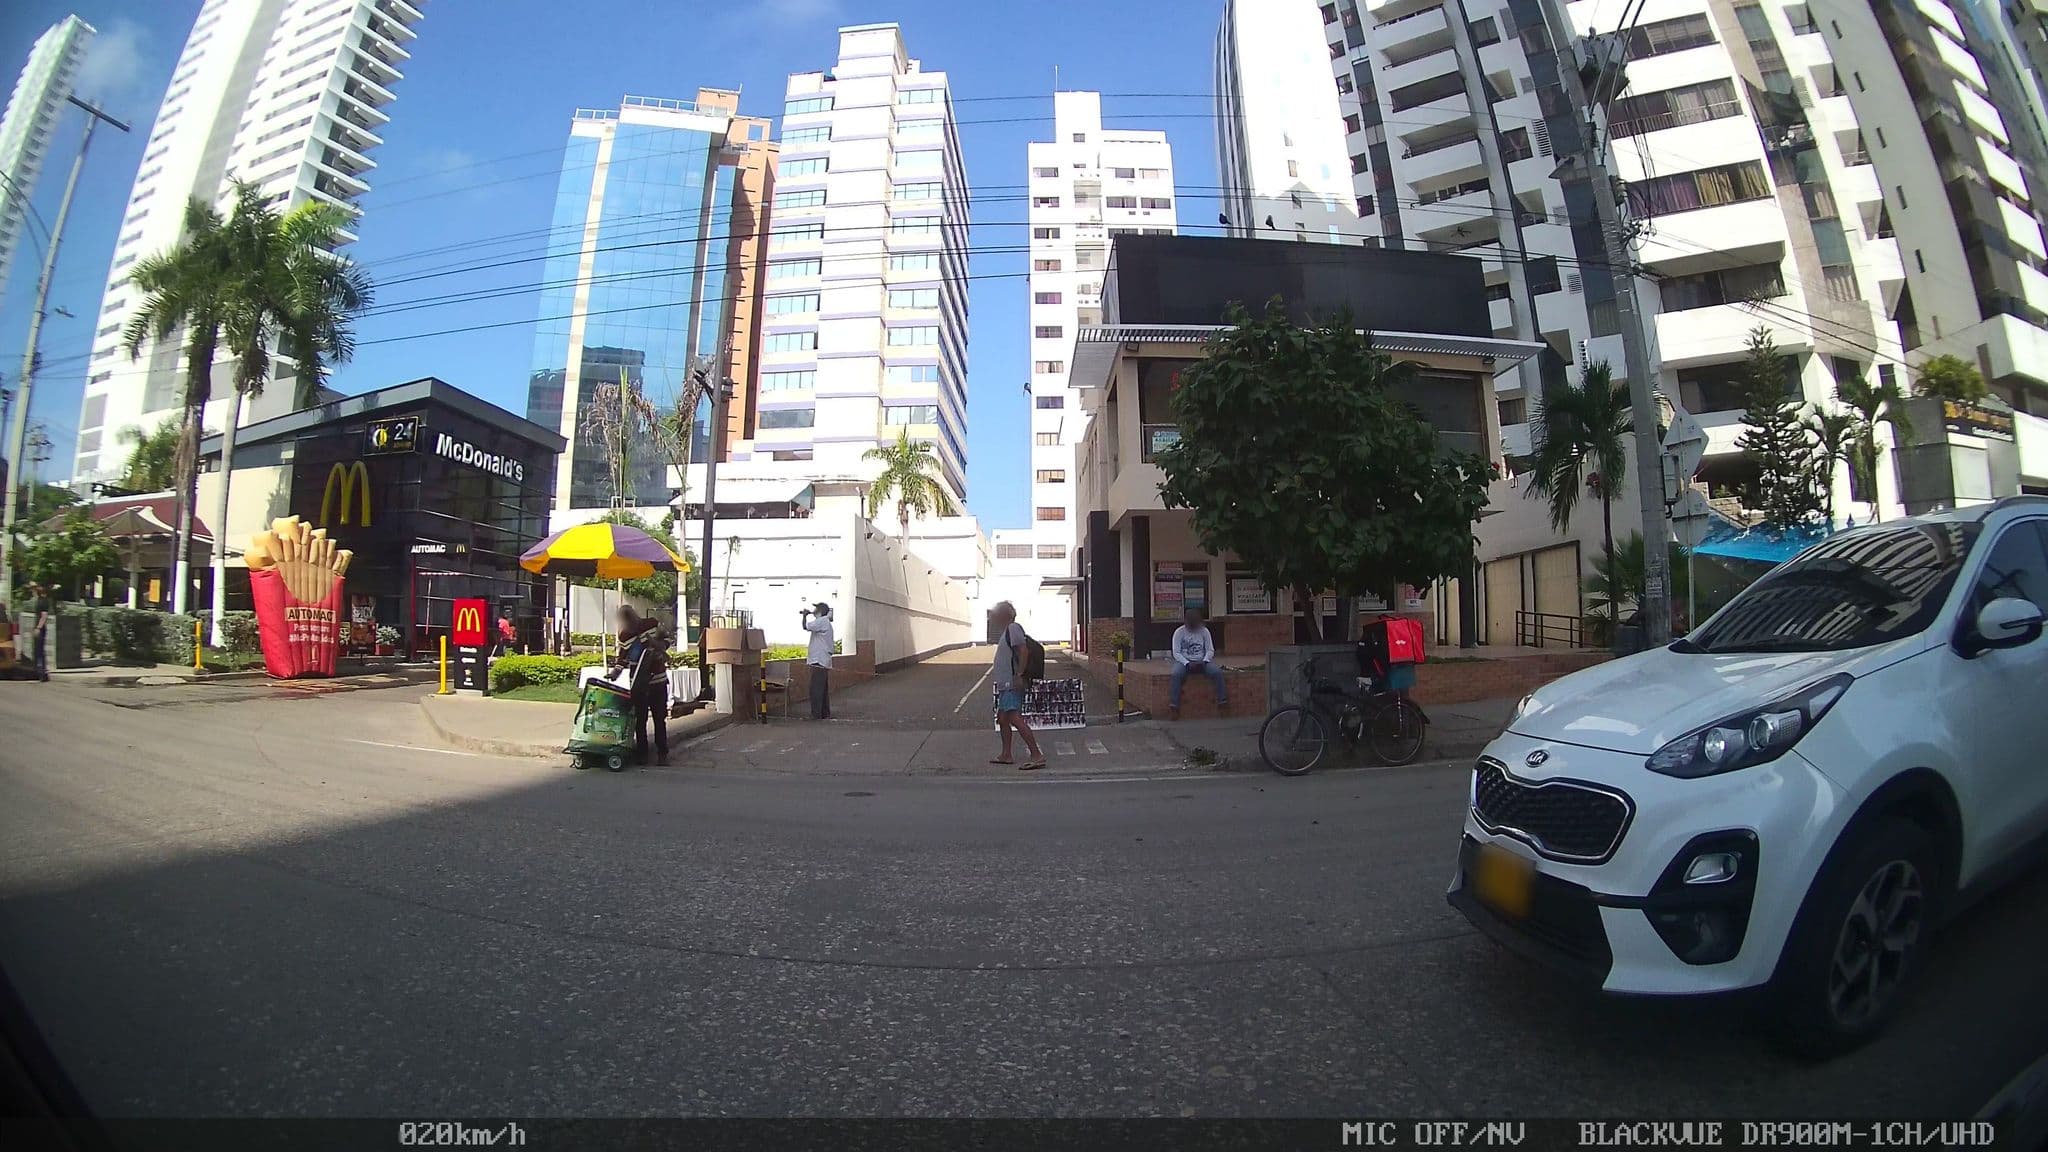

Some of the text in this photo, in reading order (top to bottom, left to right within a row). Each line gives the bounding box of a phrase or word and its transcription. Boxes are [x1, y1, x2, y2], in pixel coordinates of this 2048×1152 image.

[436, 432, 524, 481] McDonald's
[411, 545, 446, 553] AUTOMAC
[288, 608, 333, 622] AUTOMAC
